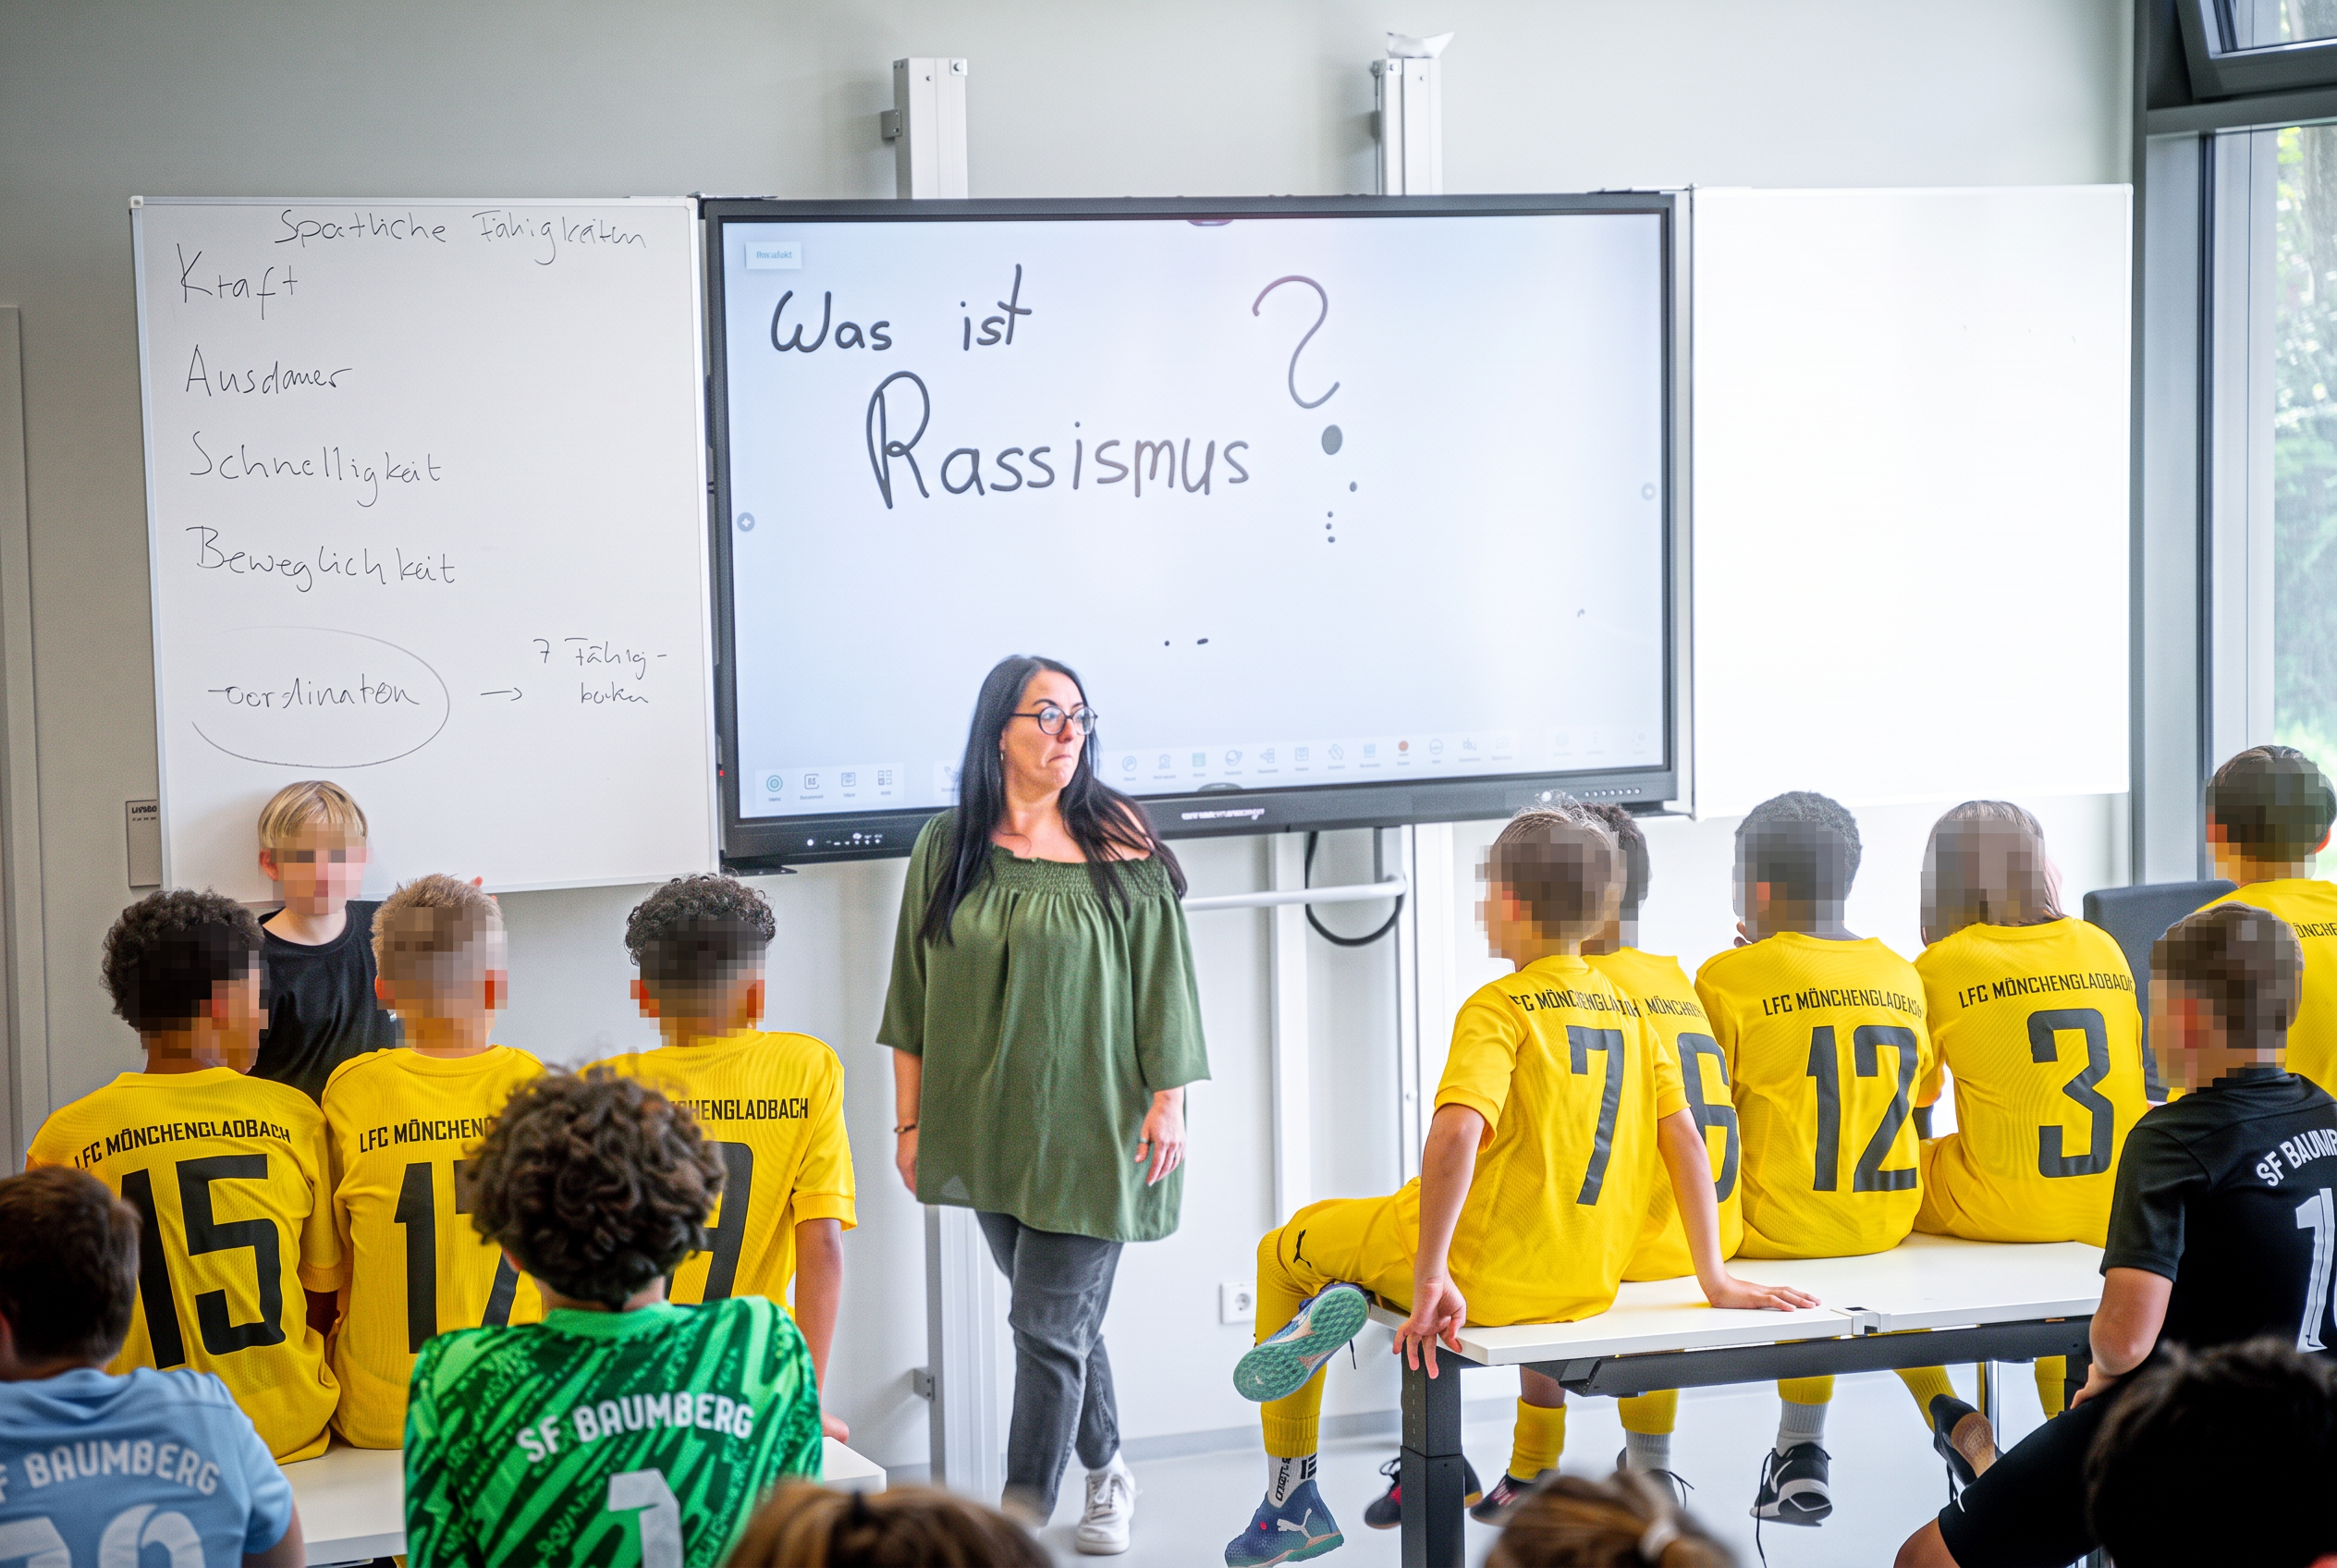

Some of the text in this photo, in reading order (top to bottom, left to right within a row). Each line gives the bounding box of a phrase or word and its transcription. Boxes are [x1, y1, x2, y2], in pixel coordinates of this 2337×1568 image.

[177, 242, 298, 320] Kraft
[771, 263, 1033, 353] Was ist
[190, 431, 441, 508] Schnelligkeit
[866, 371, 1249, 509] Rassismus
[186, 525, 455, 593] Beweglichkeit
[533, 639, 550, 663] 7
[1762, 994, 1793, 1016] LFC
[1958, 985, 1988, 1009] LFC
[1565, 1024, 1624, 1207] 7
[1677, 1032, 1739, 1204] 6
[1805, 1024, 1918, 1193] 12
[2027, 1008, 2114, 1178] 3
[105, 1119, 291, 1157] MÖNCHENGLADBACH
[360, 1126, 389, 1154] LFC
[2256, 1150, 2285, 1187] SF
[120, 1153, 287, 1371] 15
[516, 1391, 755, 1464] SF BAUMBERG
[23, 1439, 221, 1496] BAUMBERG
